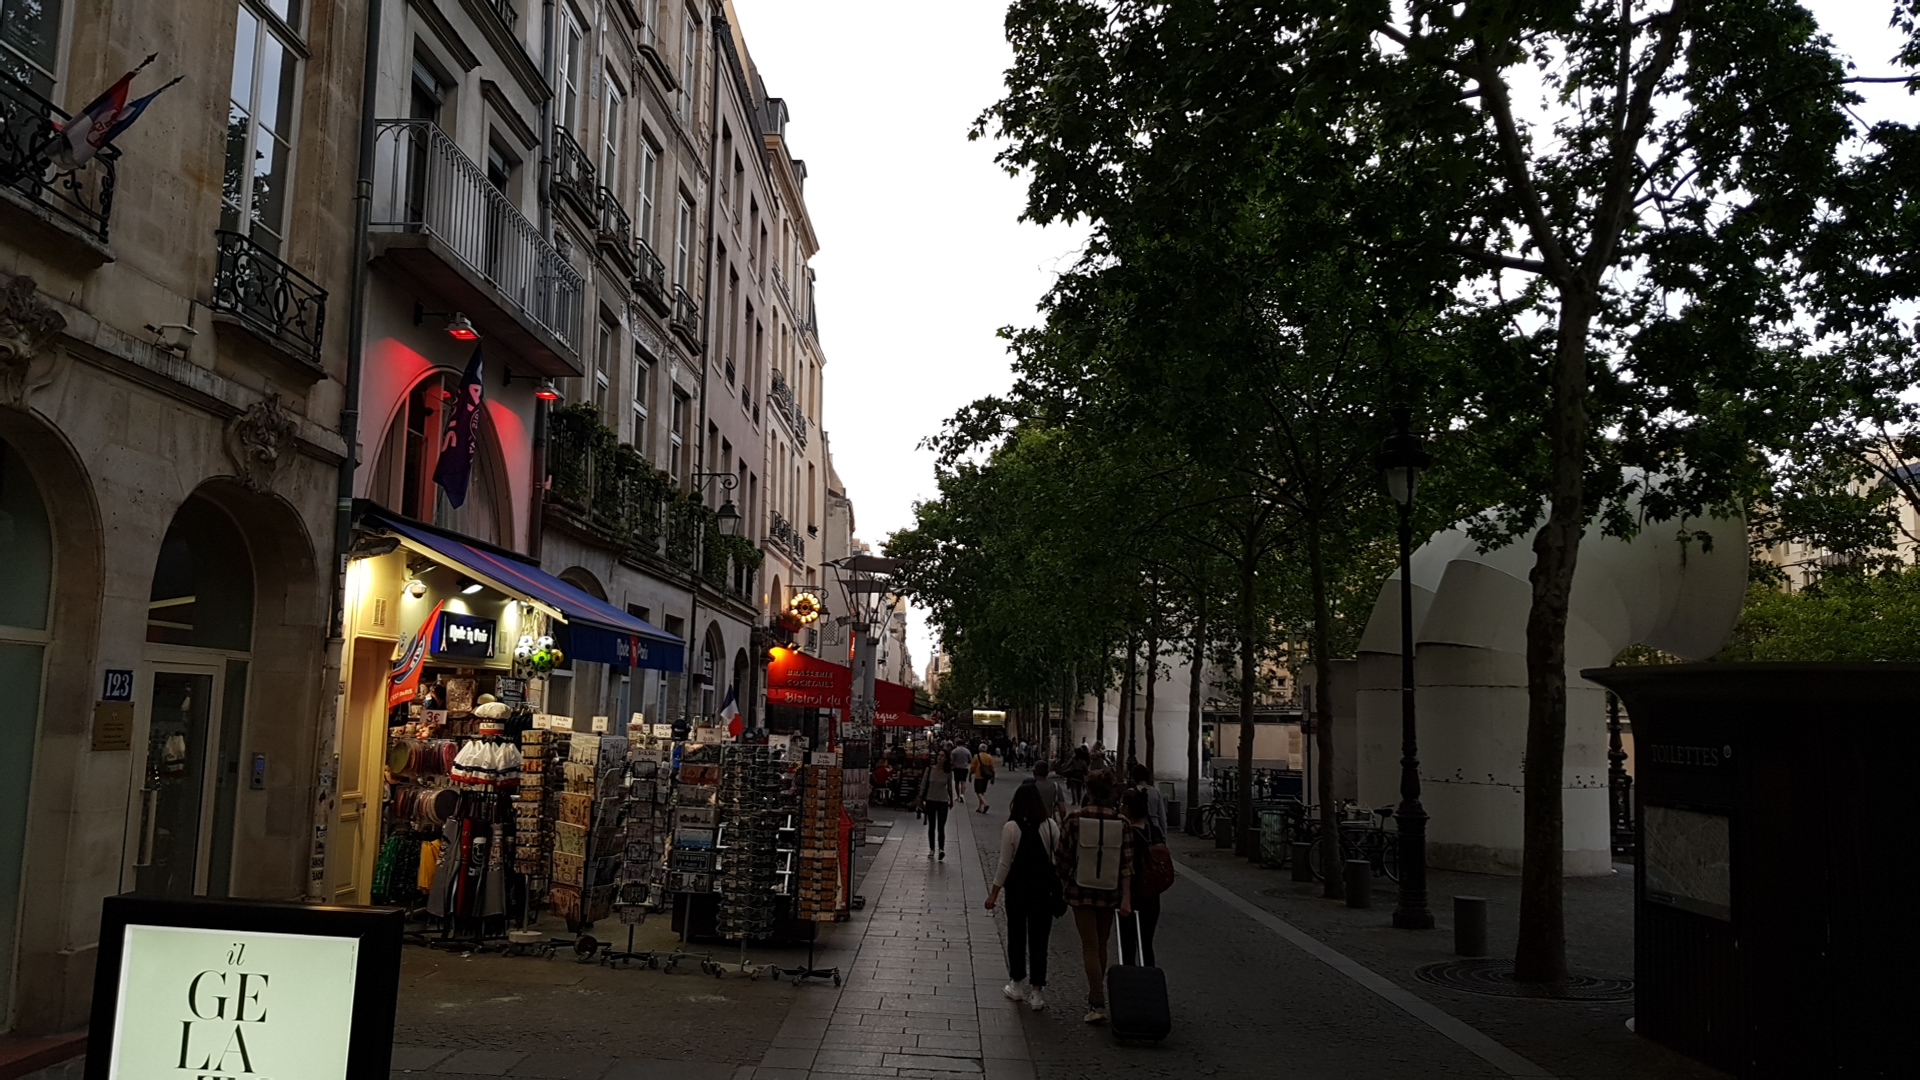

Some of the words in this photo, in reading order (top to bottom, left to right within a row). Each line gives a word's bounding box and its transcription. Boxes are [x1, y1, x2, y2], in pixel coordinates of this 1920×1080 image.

[105, 672, 130, 697] 123
[786, 669, 834, 679] BRASSERIE
[786, 679, 834, 689] COCKTAILS
[784, 691, 823, 705] Bistrot
[827, 694, 841, 706] du
[426, 711, 440, 723] 3€
[1650, 744, 1719, 767] TOILETTES
[225, 942, 247, 967] il
[187, 969, 271, 1023] GE
[175, 1020, 256, 1074] LA
